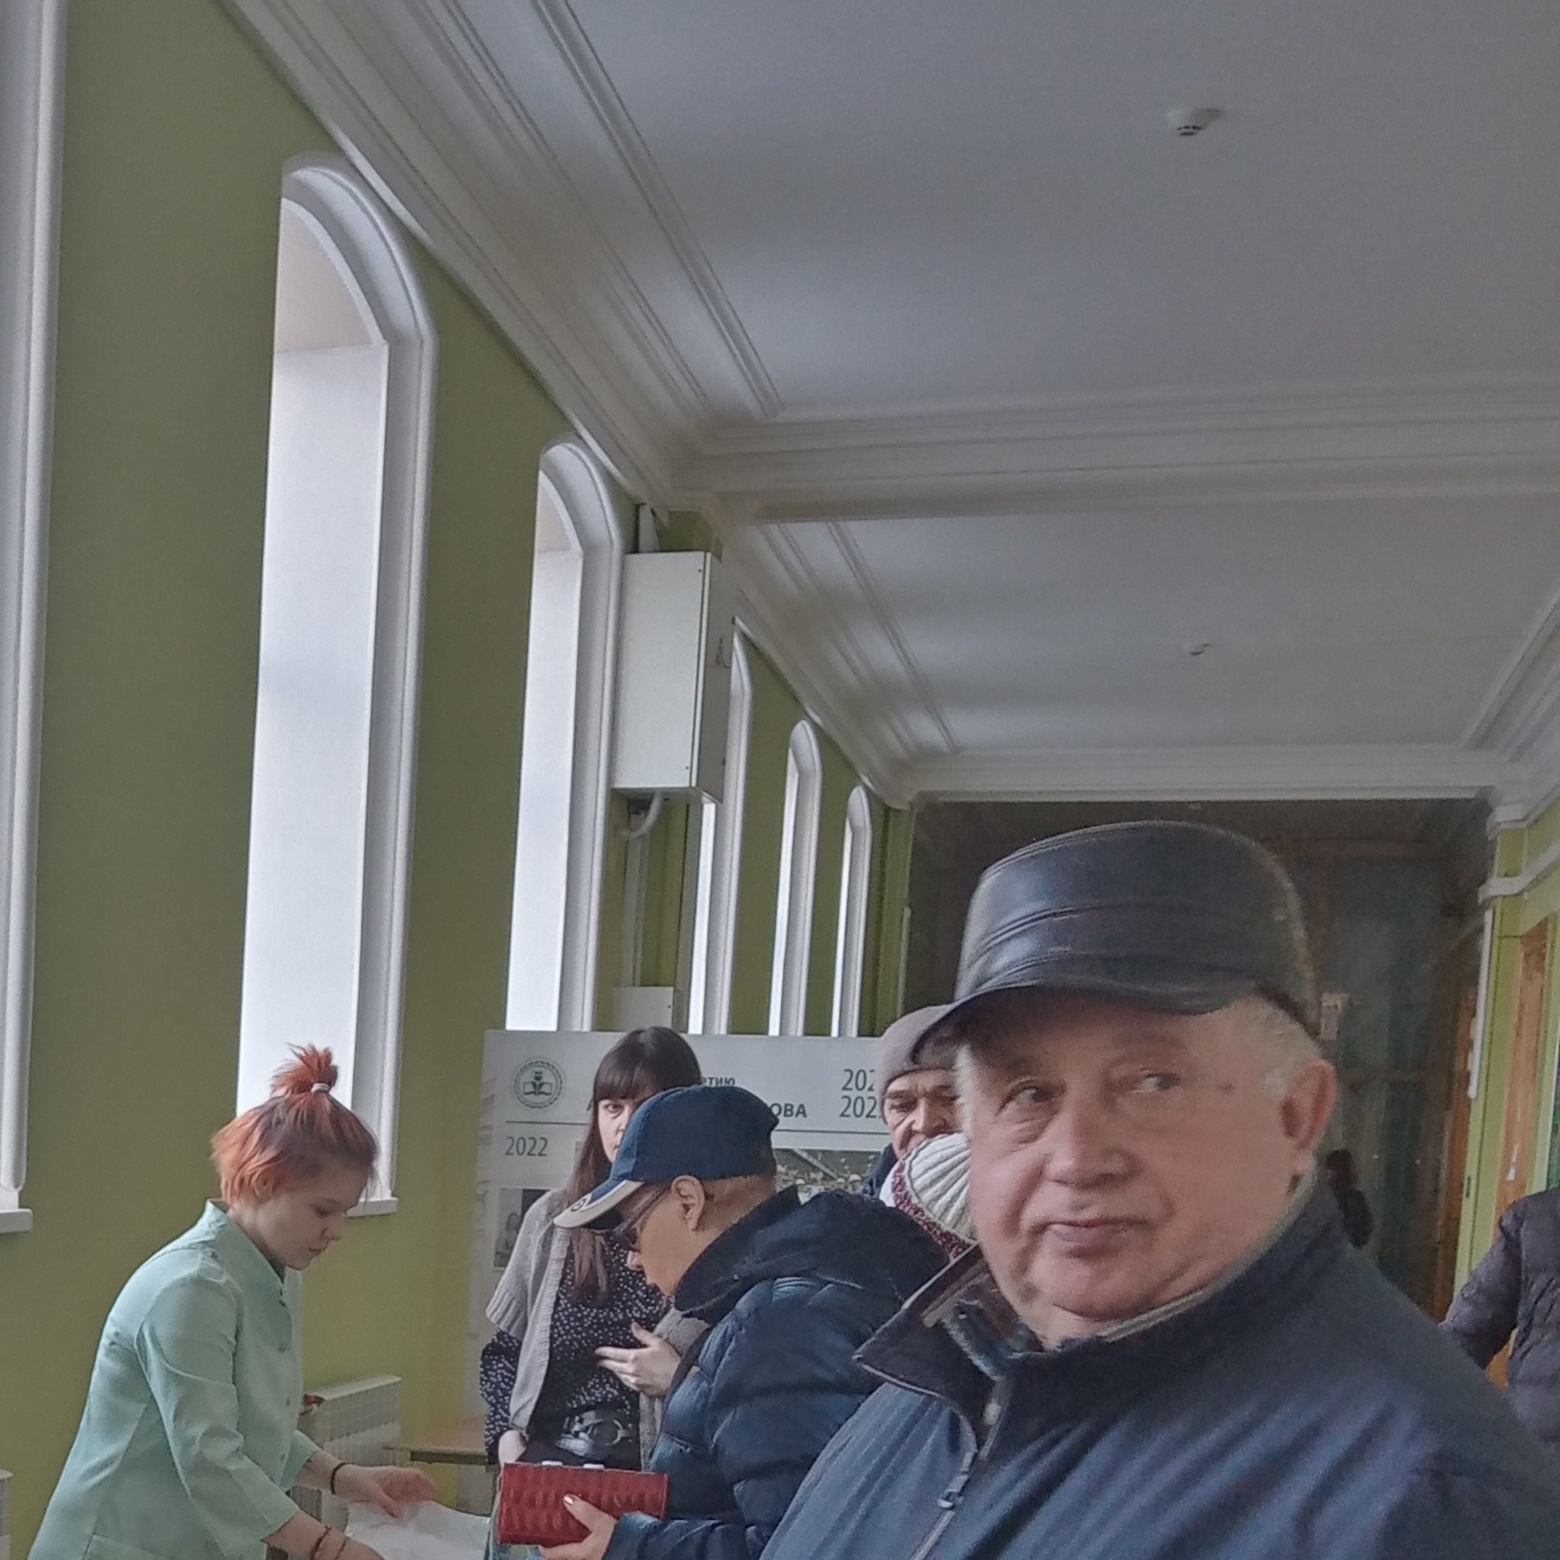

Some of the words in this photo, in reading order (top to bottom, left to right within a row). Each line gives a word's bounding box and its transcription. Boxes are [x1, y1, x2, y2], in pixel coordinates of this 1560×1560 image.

[841, 1068, 876, 1092] 202
[768, 1102, 808, 1118] ОВА
[839, 1095, 882, 1119] 202
[504, 1136, 549, 1157] 2022
